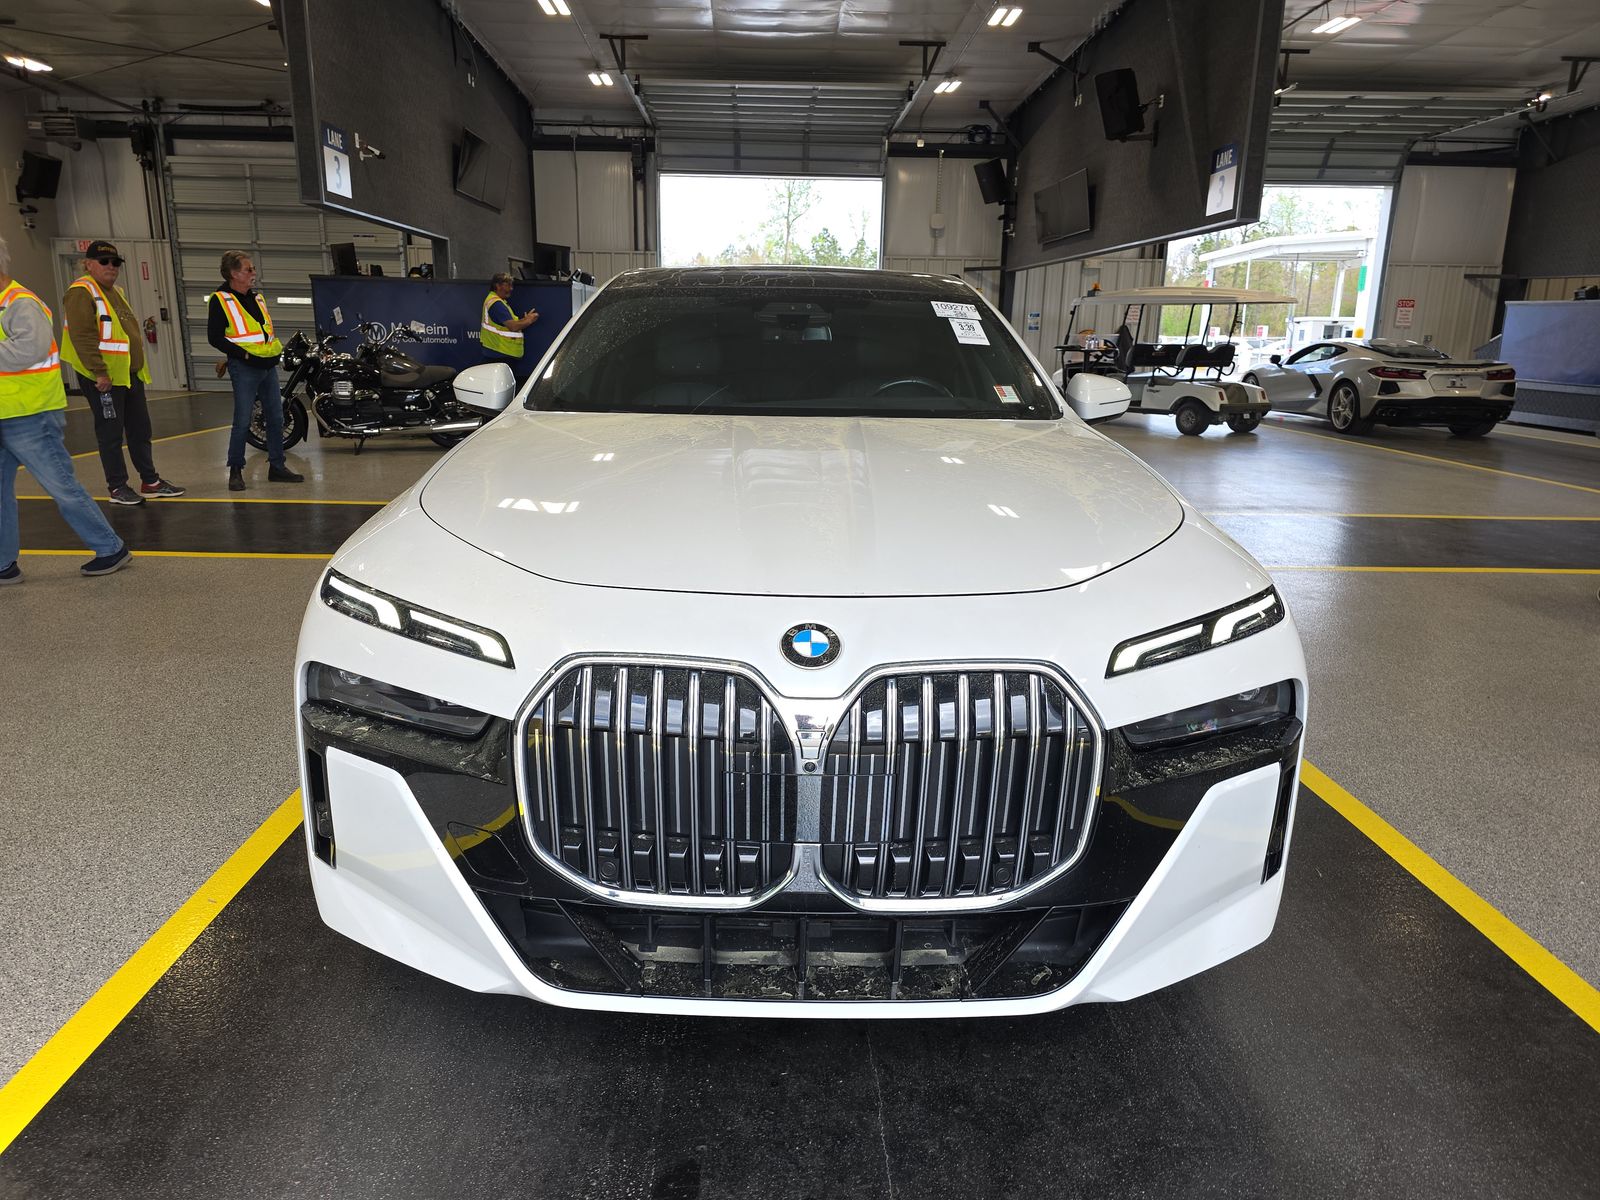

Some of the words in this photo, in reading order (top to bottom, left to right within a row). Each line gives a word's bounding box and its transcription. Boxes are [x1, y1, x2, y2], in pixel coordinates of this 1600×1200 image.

[327, 128, 343, 149] LANE
[1216, 149, 1233, 168] LANE
[333, 155, 342, 189] 3
[1215, 175, 1226, 208] 3
[787, 622, 836, 638] BMW
